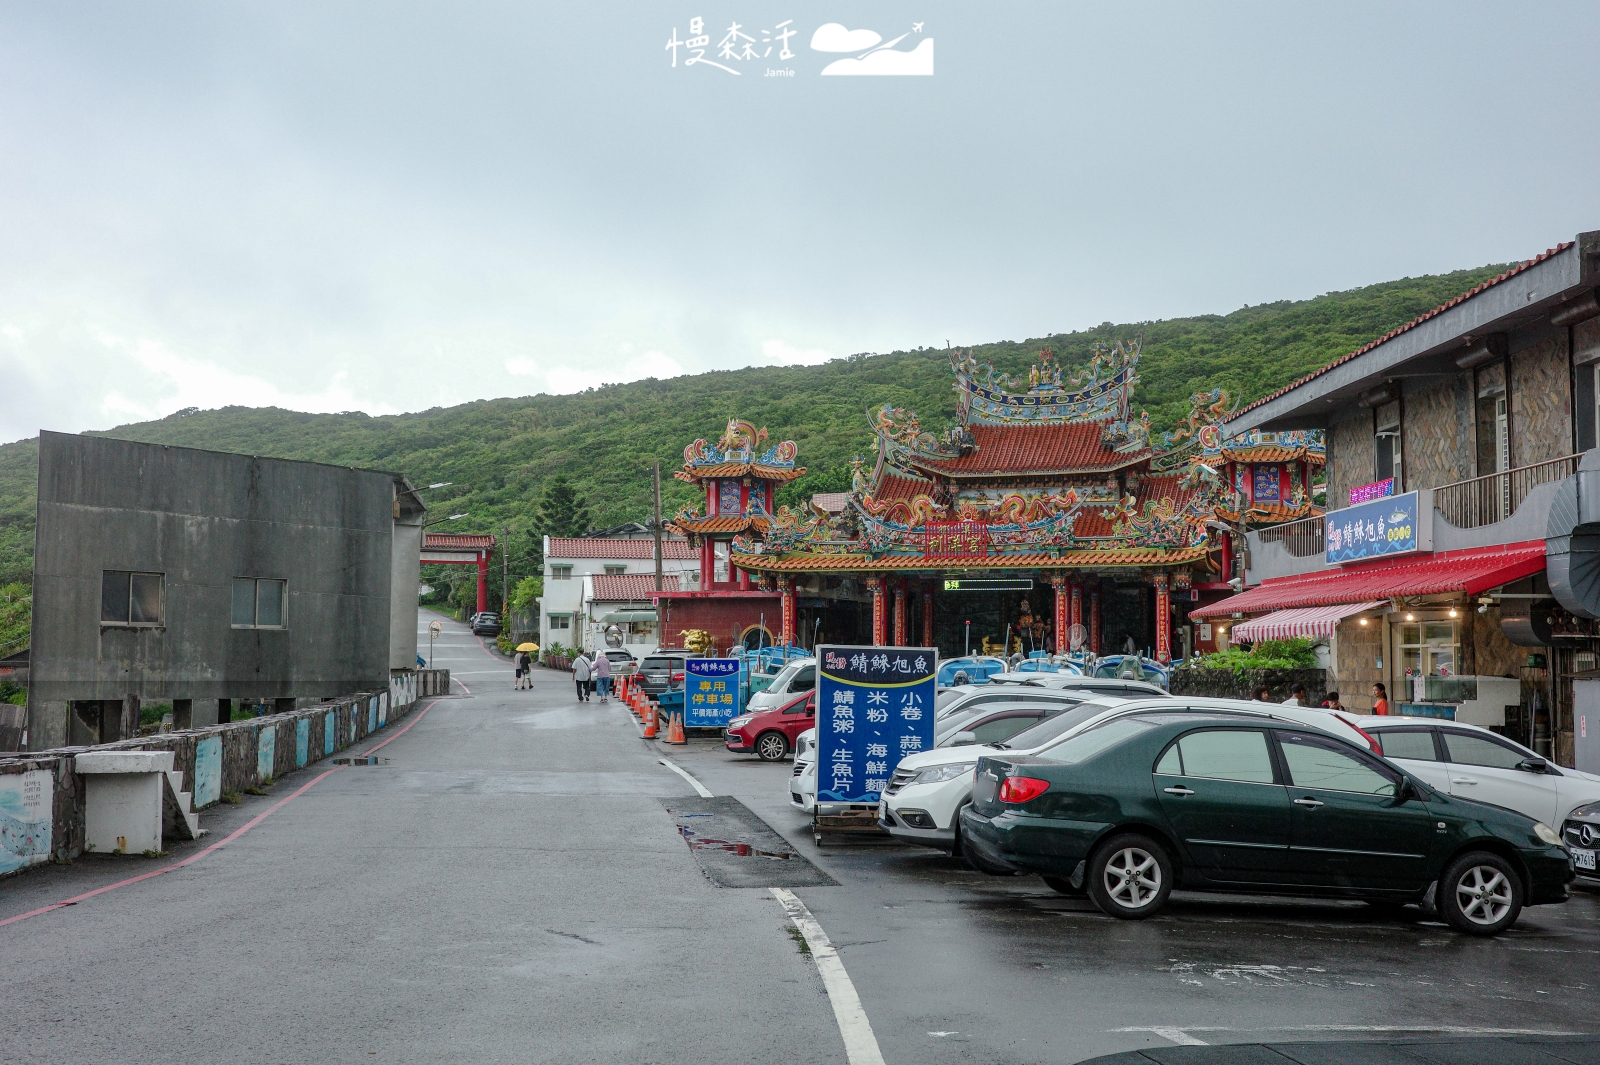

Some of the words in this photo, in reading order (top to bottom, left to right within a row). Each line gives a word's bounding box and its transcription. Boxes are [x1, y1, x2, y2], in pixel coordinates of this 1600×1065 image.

[698, 681, 727, 692] 專用
[691, 693, 733, 705] 停車場
[691, 708, 733, 717] 平價海產小吃
[831, 689, 856, 792] 鯖魚粥、生魚片
[865, 691, 889, 793] 米粉、海鮮麵
